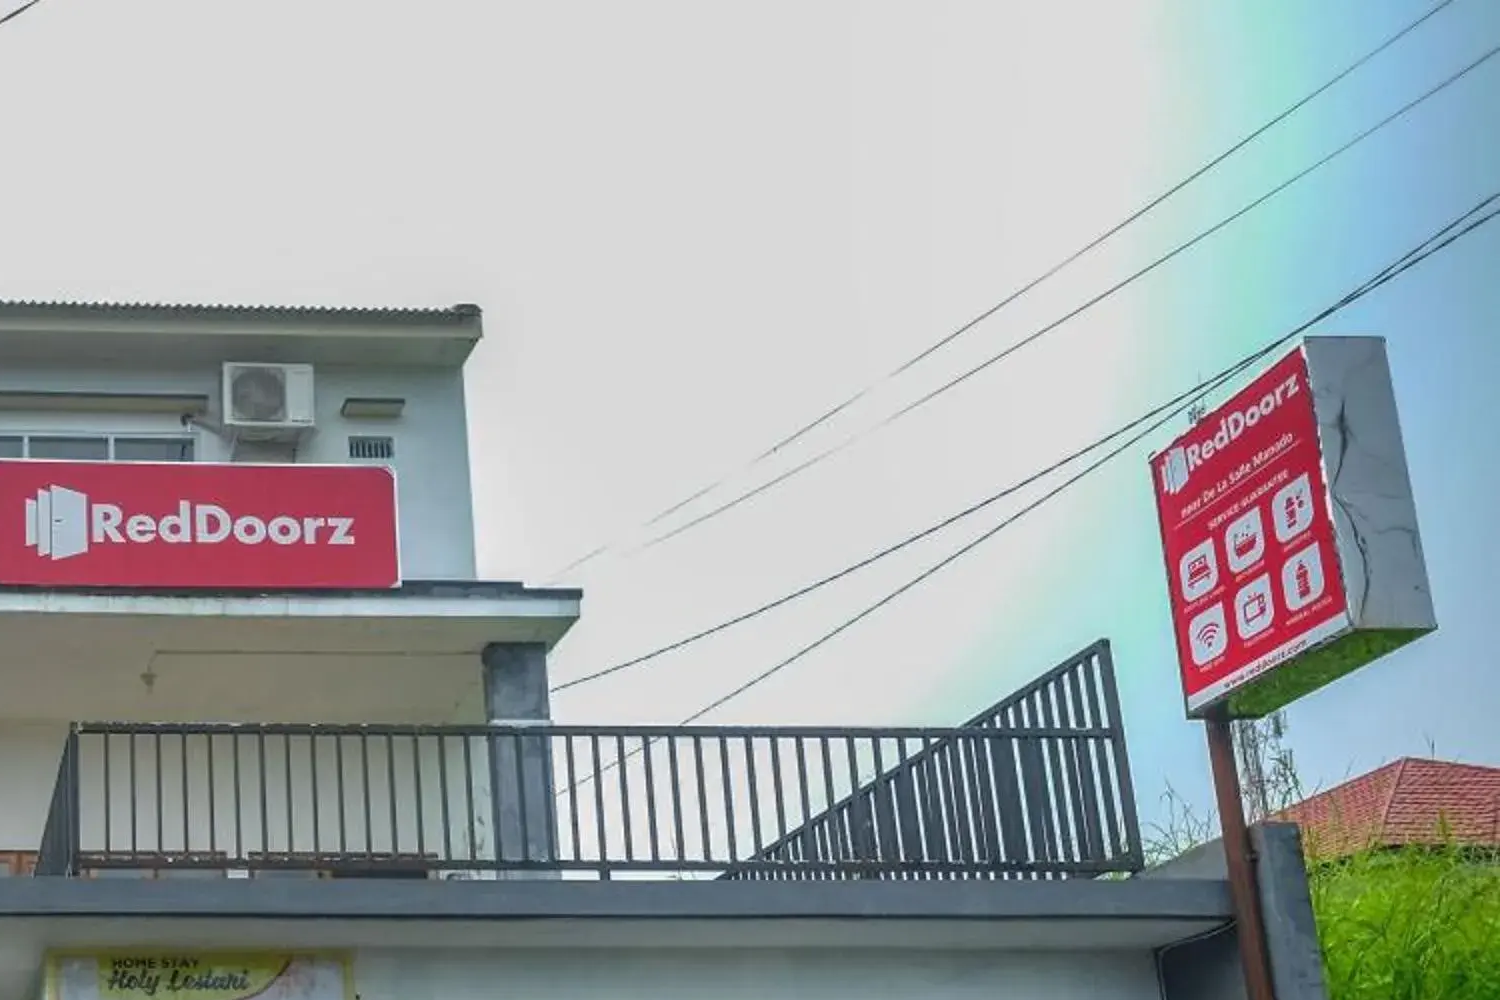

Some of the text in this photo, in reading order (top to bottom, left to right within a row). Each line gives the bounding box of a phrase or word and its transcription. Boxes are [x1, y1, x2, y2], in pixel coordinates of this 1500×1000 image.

[1186, 373, 1300, 471] RedDoorz
[91, 500, 356, 546] RedDoorz
[112, 958, 199, 969] HOME STAY
